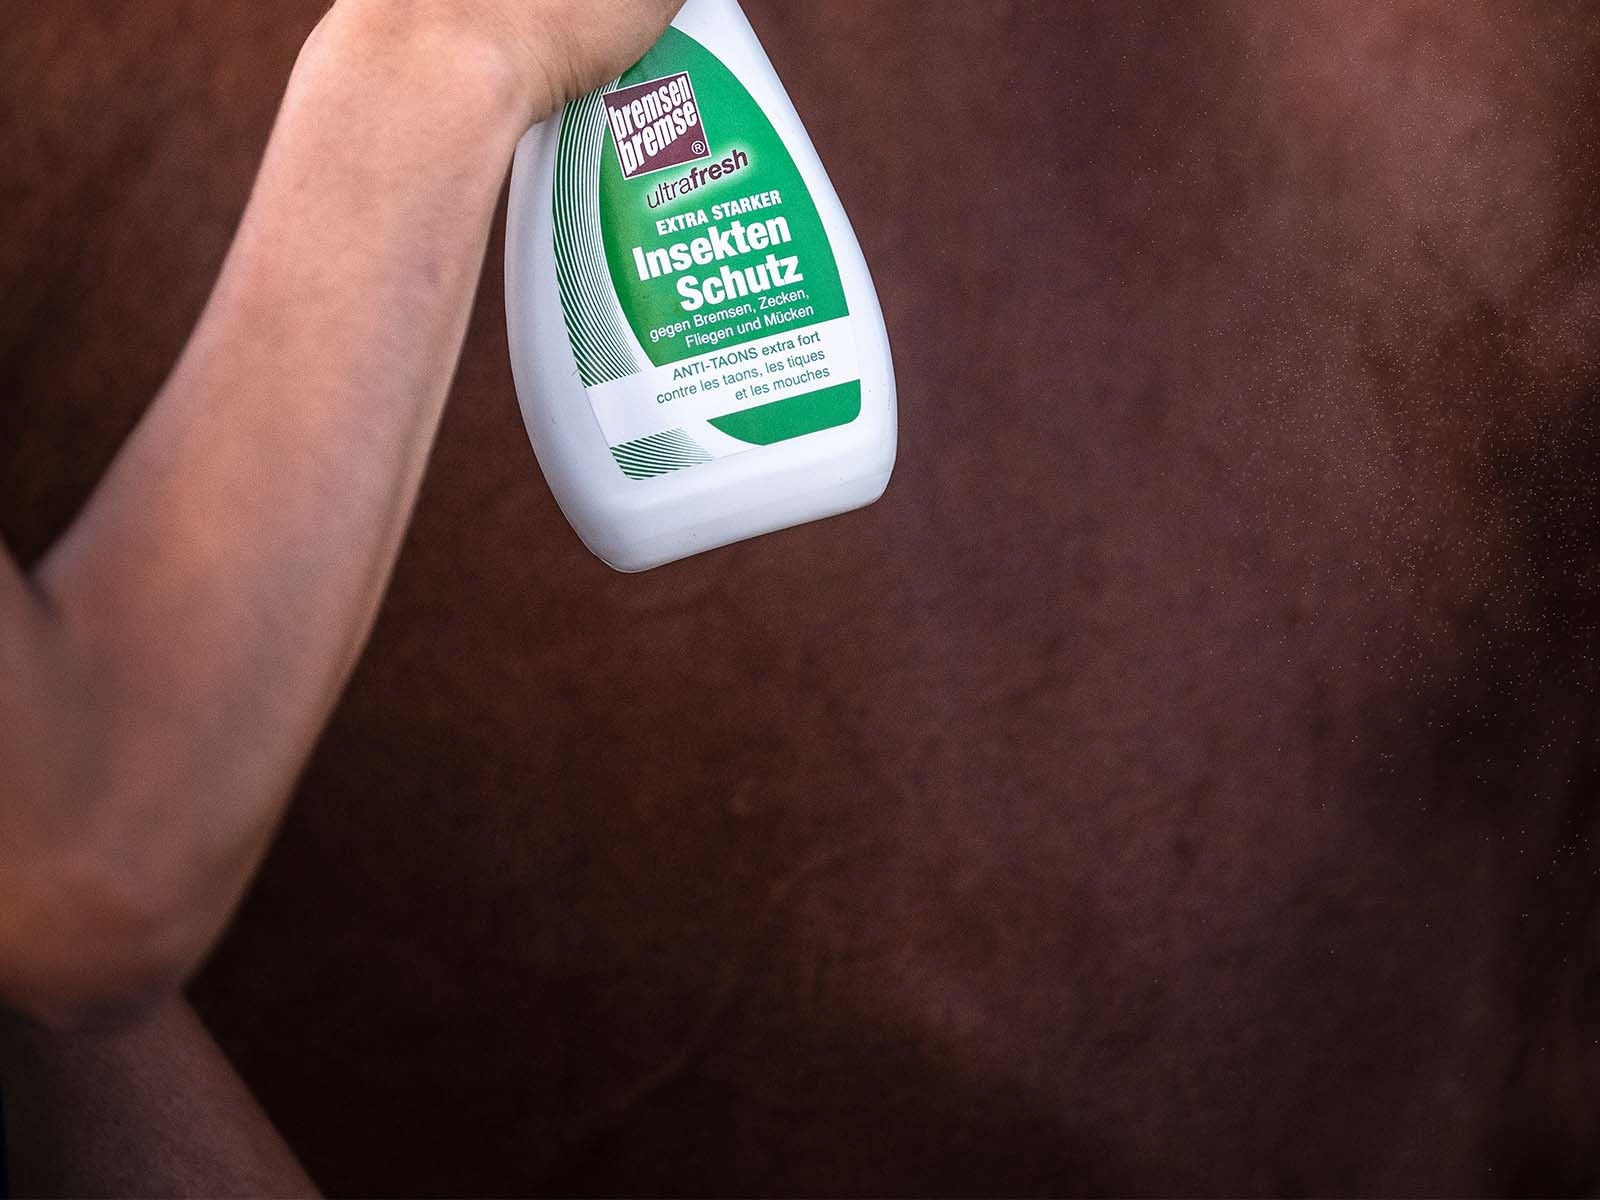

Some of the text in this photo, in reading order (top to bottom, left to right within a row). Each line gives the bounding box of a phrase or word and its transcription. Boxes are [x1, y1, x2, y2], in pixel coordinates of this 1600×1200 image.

[608, 75, 691, 141] bremsen
[618, 100, 698, 176] bremse
[646, 149, 748, 208] ultrafresh
[655, 190, 782, 236] EXTRA STARKER
[632, 215, 792, 281] Insekten
[676, 254, 804, 311] Schutz
[649, 289, 809, 342] gegen Bremsen, Zecken,
[685, 305, 814, 348] Fliegen und Mücken
[656, 350, 826, 404] contre les taons, les tiques
[672, 331, 821, 381] ANTI-TAONS extra fort
[735, 366, 831, 401] et les mouches
